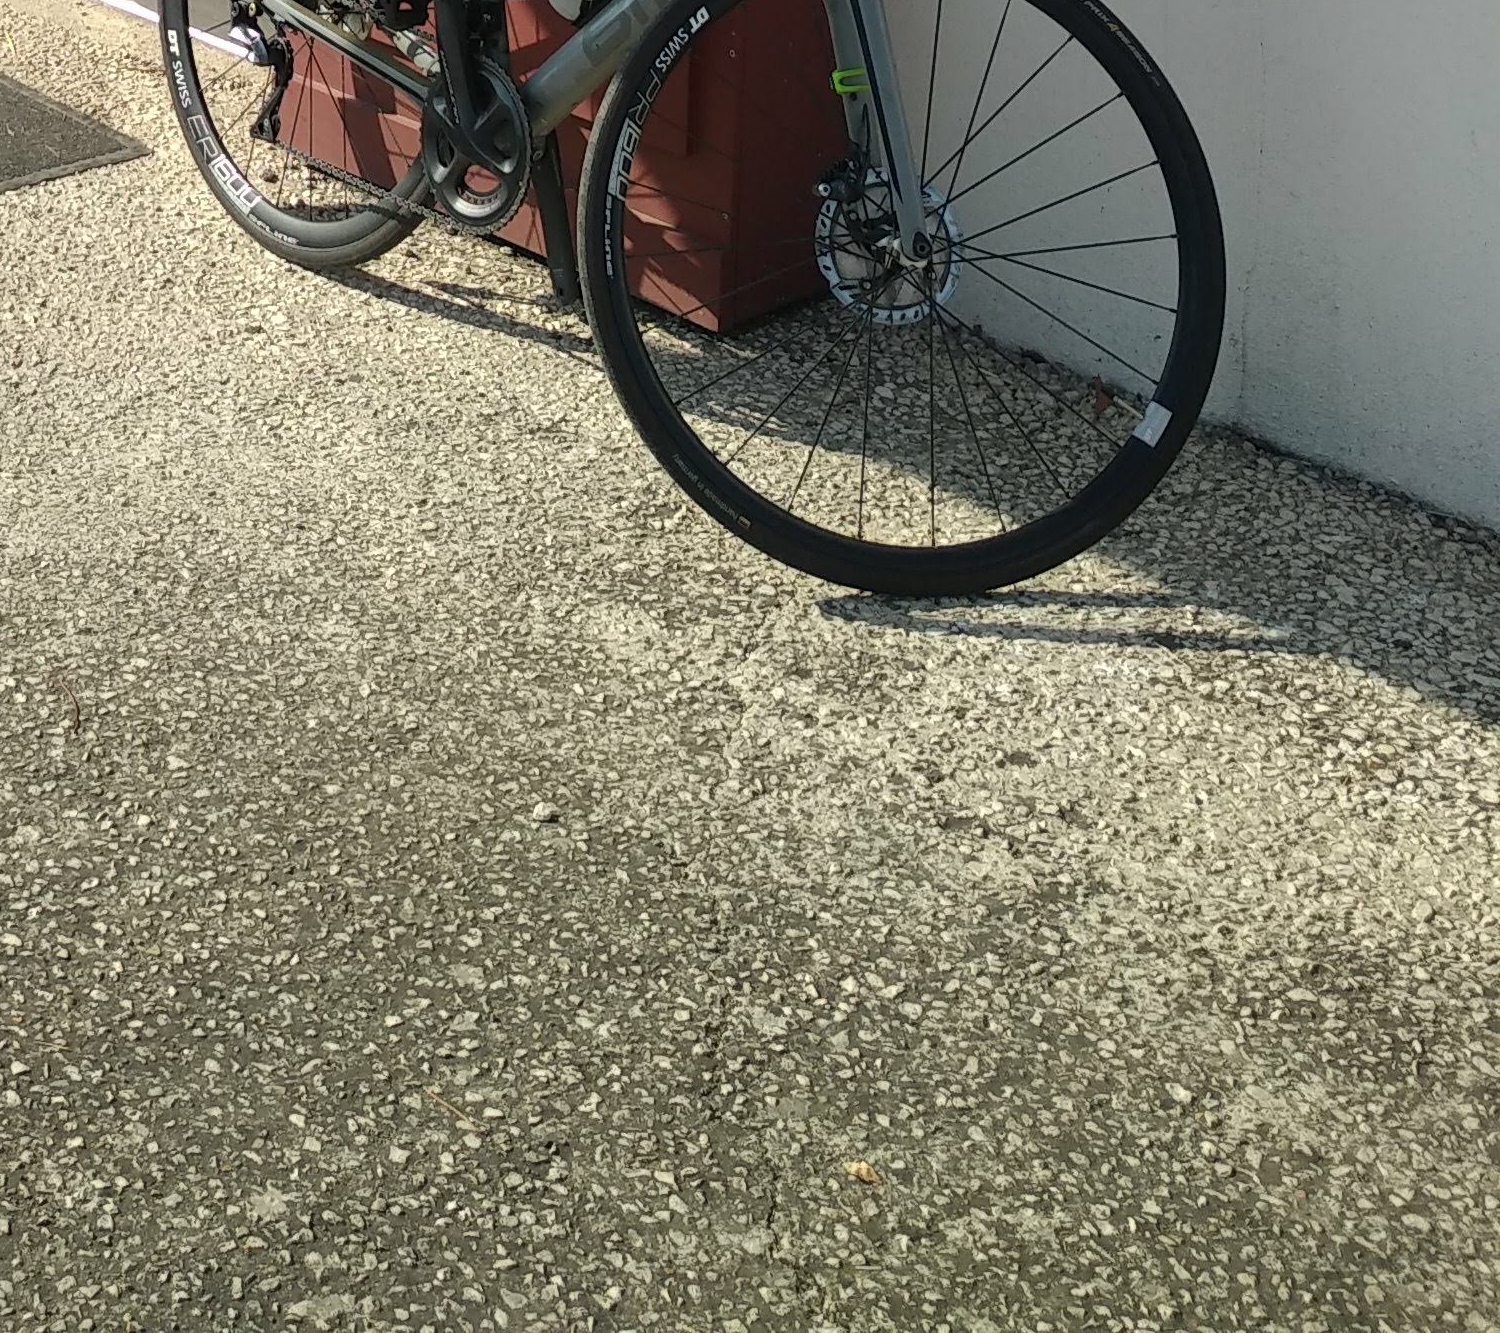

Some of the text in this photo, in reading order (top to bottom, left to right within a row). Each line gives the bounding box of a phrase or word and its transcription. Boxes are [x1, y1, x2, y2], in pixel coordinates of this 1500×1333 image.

[688, 5, 710, 35] DT
[167, 29, 180, 57] DT
[655, 27, 689, 74] SWISS
[172, 61, 192, 109] SWISS
